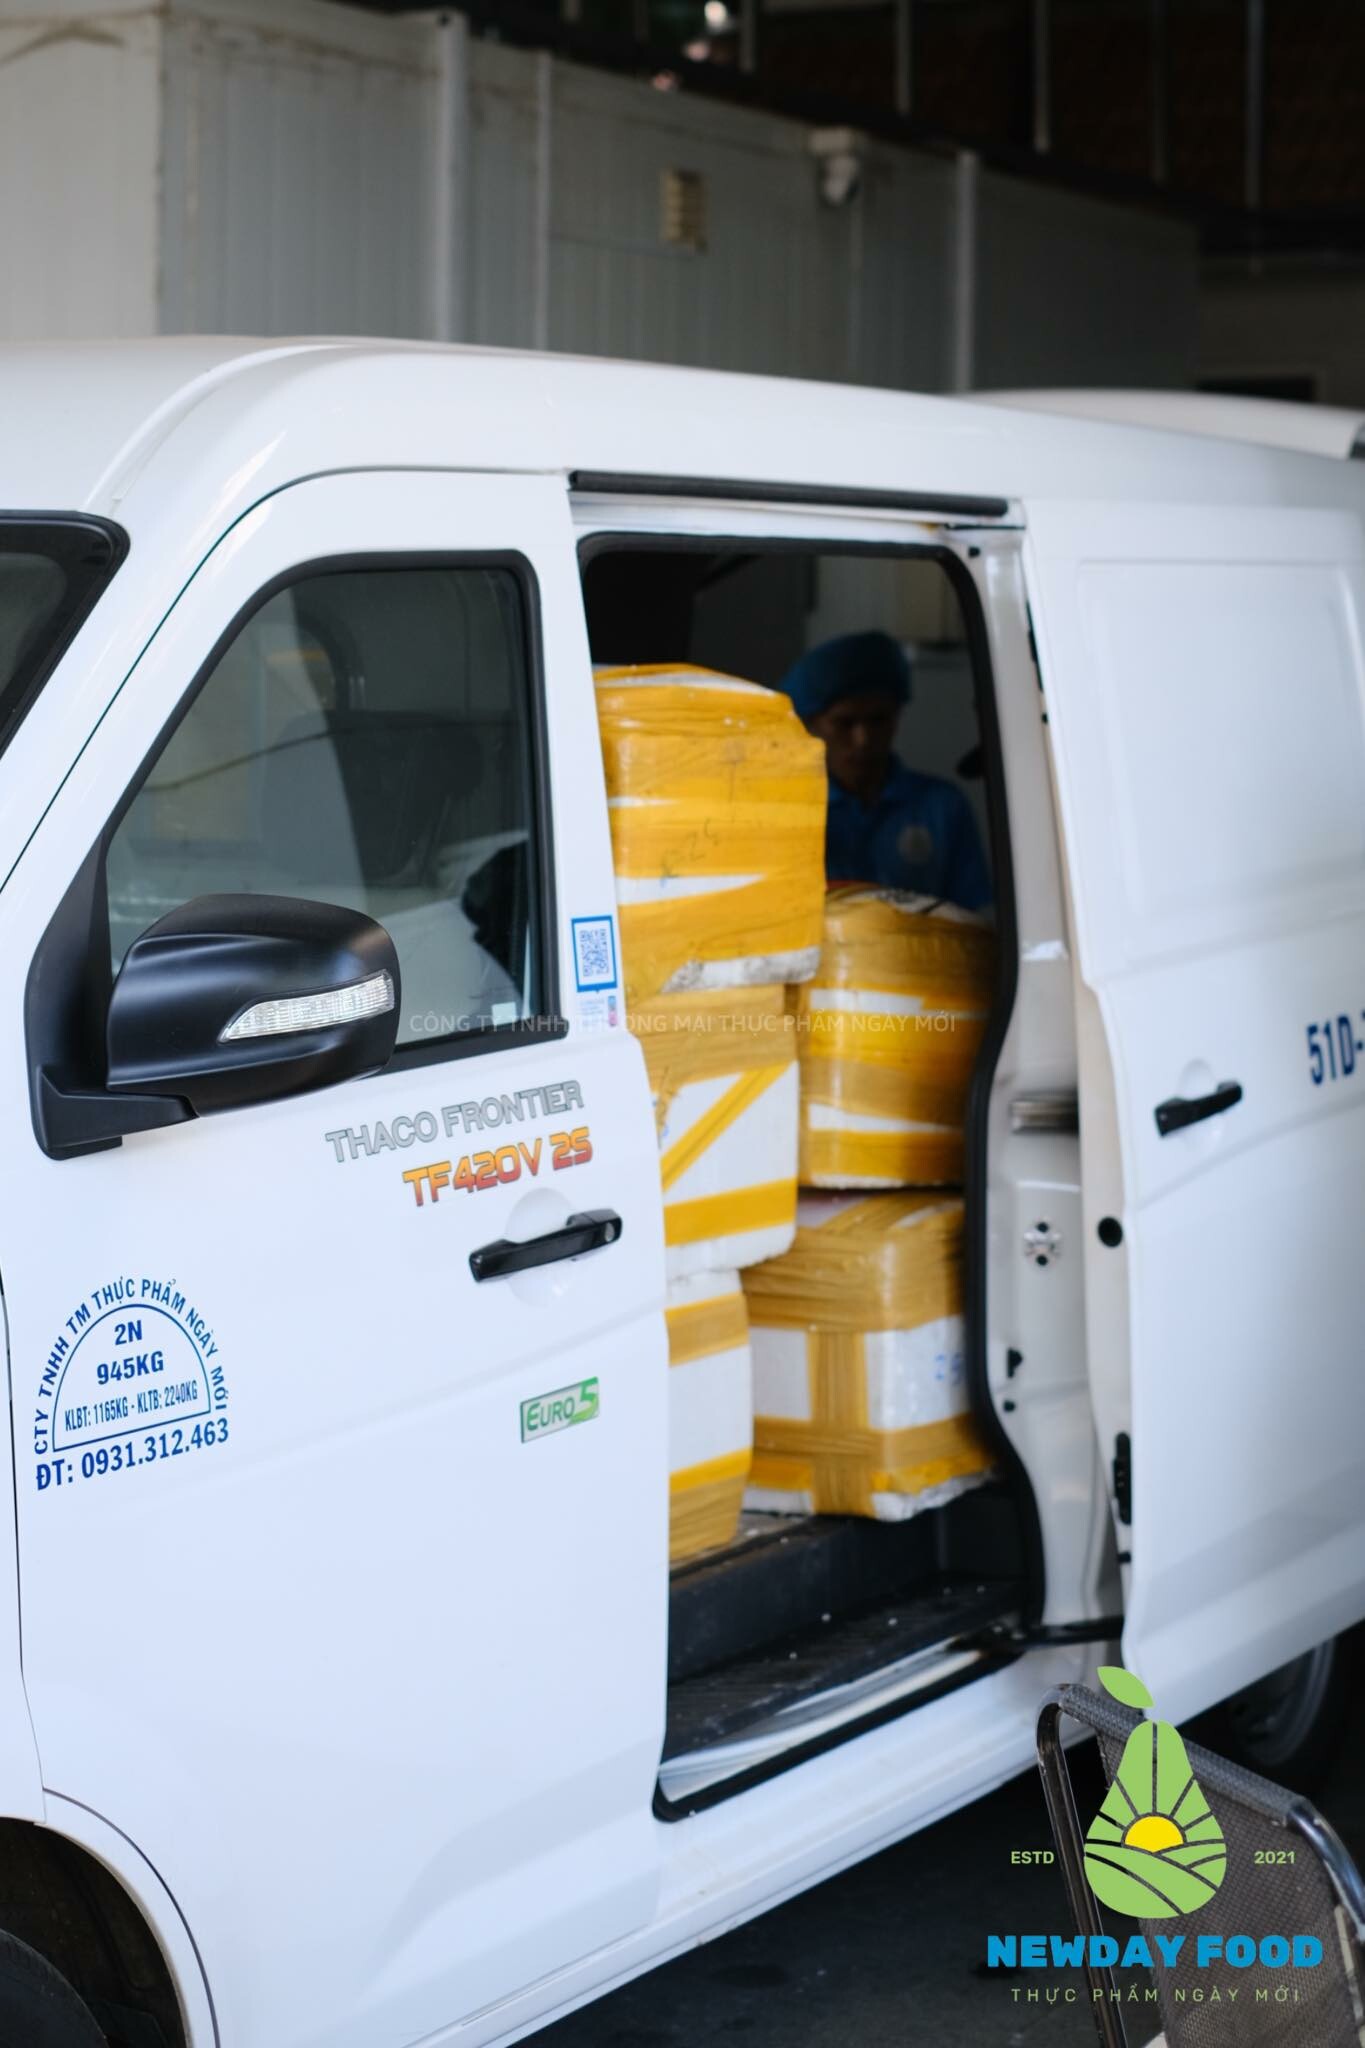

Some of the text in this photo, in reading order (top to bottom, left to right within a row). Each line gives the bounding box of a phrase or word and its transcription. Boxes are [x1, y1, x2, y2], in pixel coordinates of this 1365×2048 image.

[1307, 1009, 1365, 1085] 51D-
[325, 1079, 585, 1163] THACO FRONTIER
[402, 1138, 542, 1208] TF420V
[66, 1303, 91, 1334] TM
[114, 1320, 143, 1345] 2N
[185, 1307, 218, 1358] NGÀY
[38, 1336, 70, 1398] TNHH
[97, 1351, 164, 1385] 945KG
[65, 1405, 91, 1431] KLBT:
[93, 1396, 129, 1425] 1165KG
[164, 1379, 198, 1409] 2240KG
[34, 1409, 49, 1455] CTY
[36, 1417, 229, 1490] ĐT: 0931.312.463
